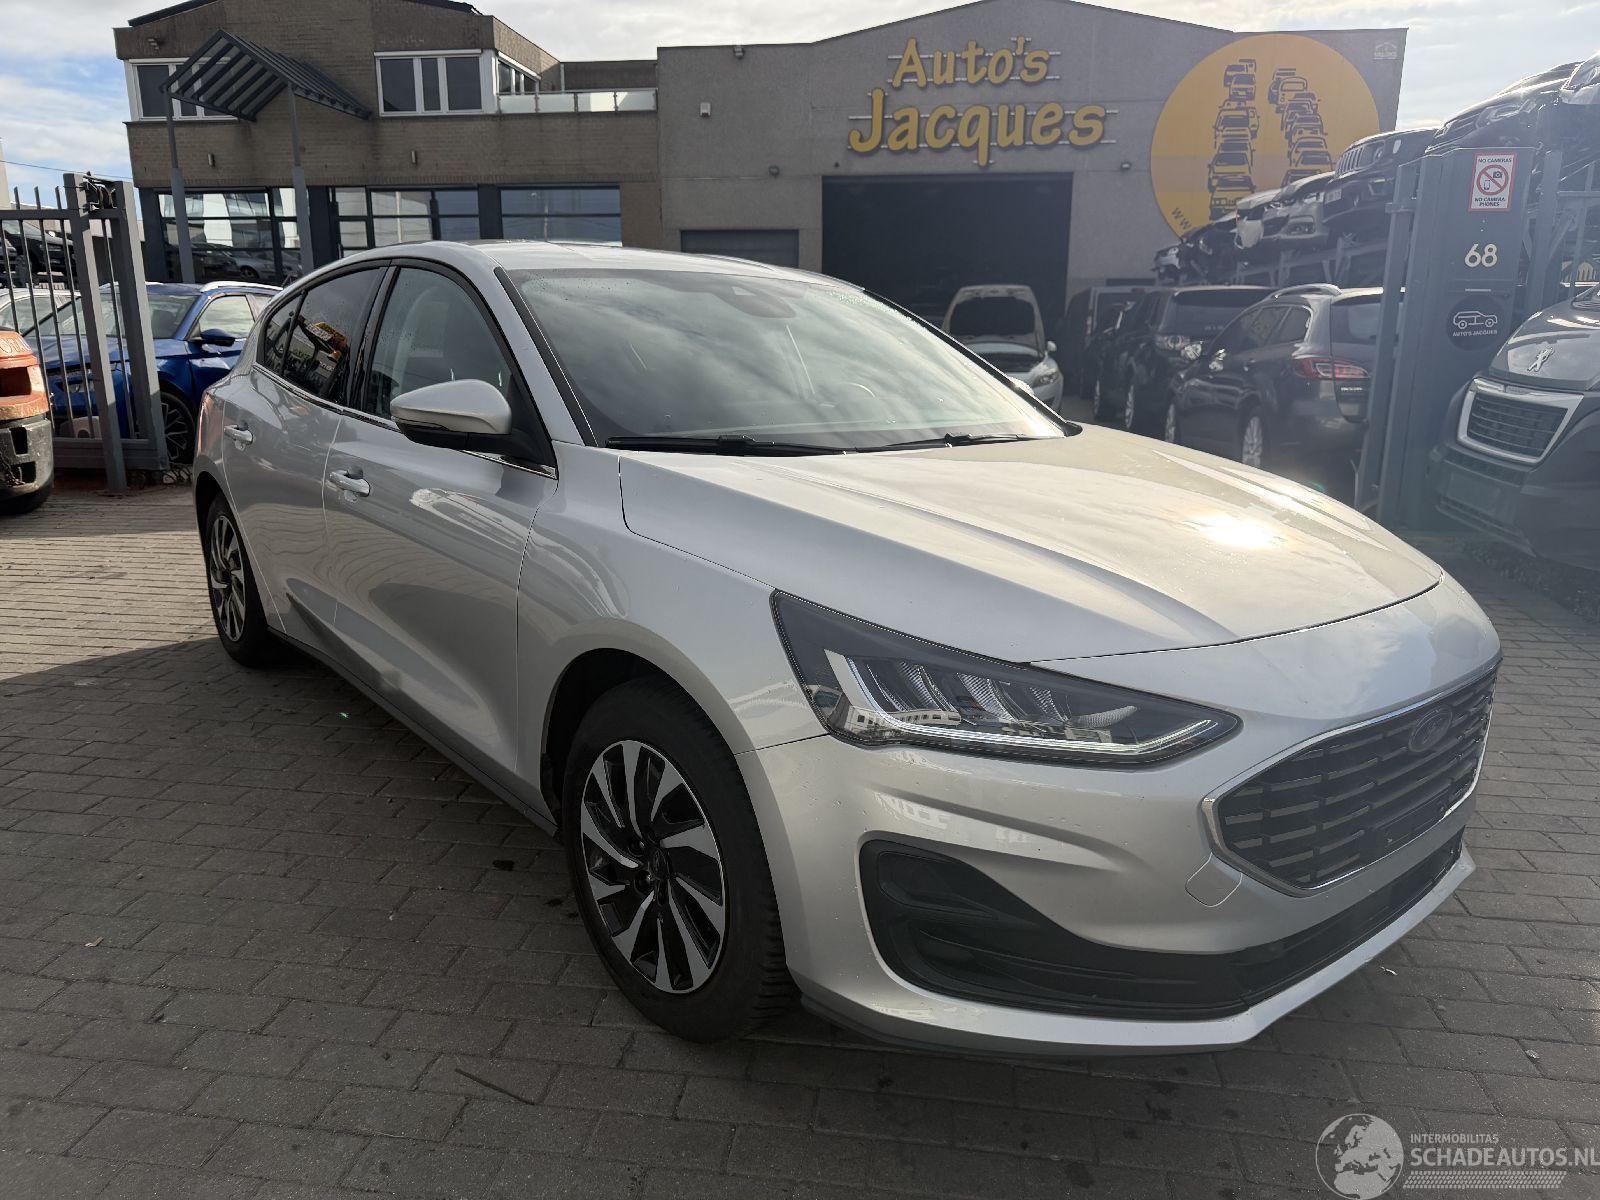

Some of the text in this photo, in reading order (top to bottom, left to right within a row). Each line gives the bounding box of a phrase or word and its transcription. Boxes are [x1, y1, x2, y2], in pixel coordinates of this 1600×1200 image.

[892, 36, 1050, 88] Auto's
[849, 88, 1105, 167] Jacques
[1464, 243, 1498, 268] 68
